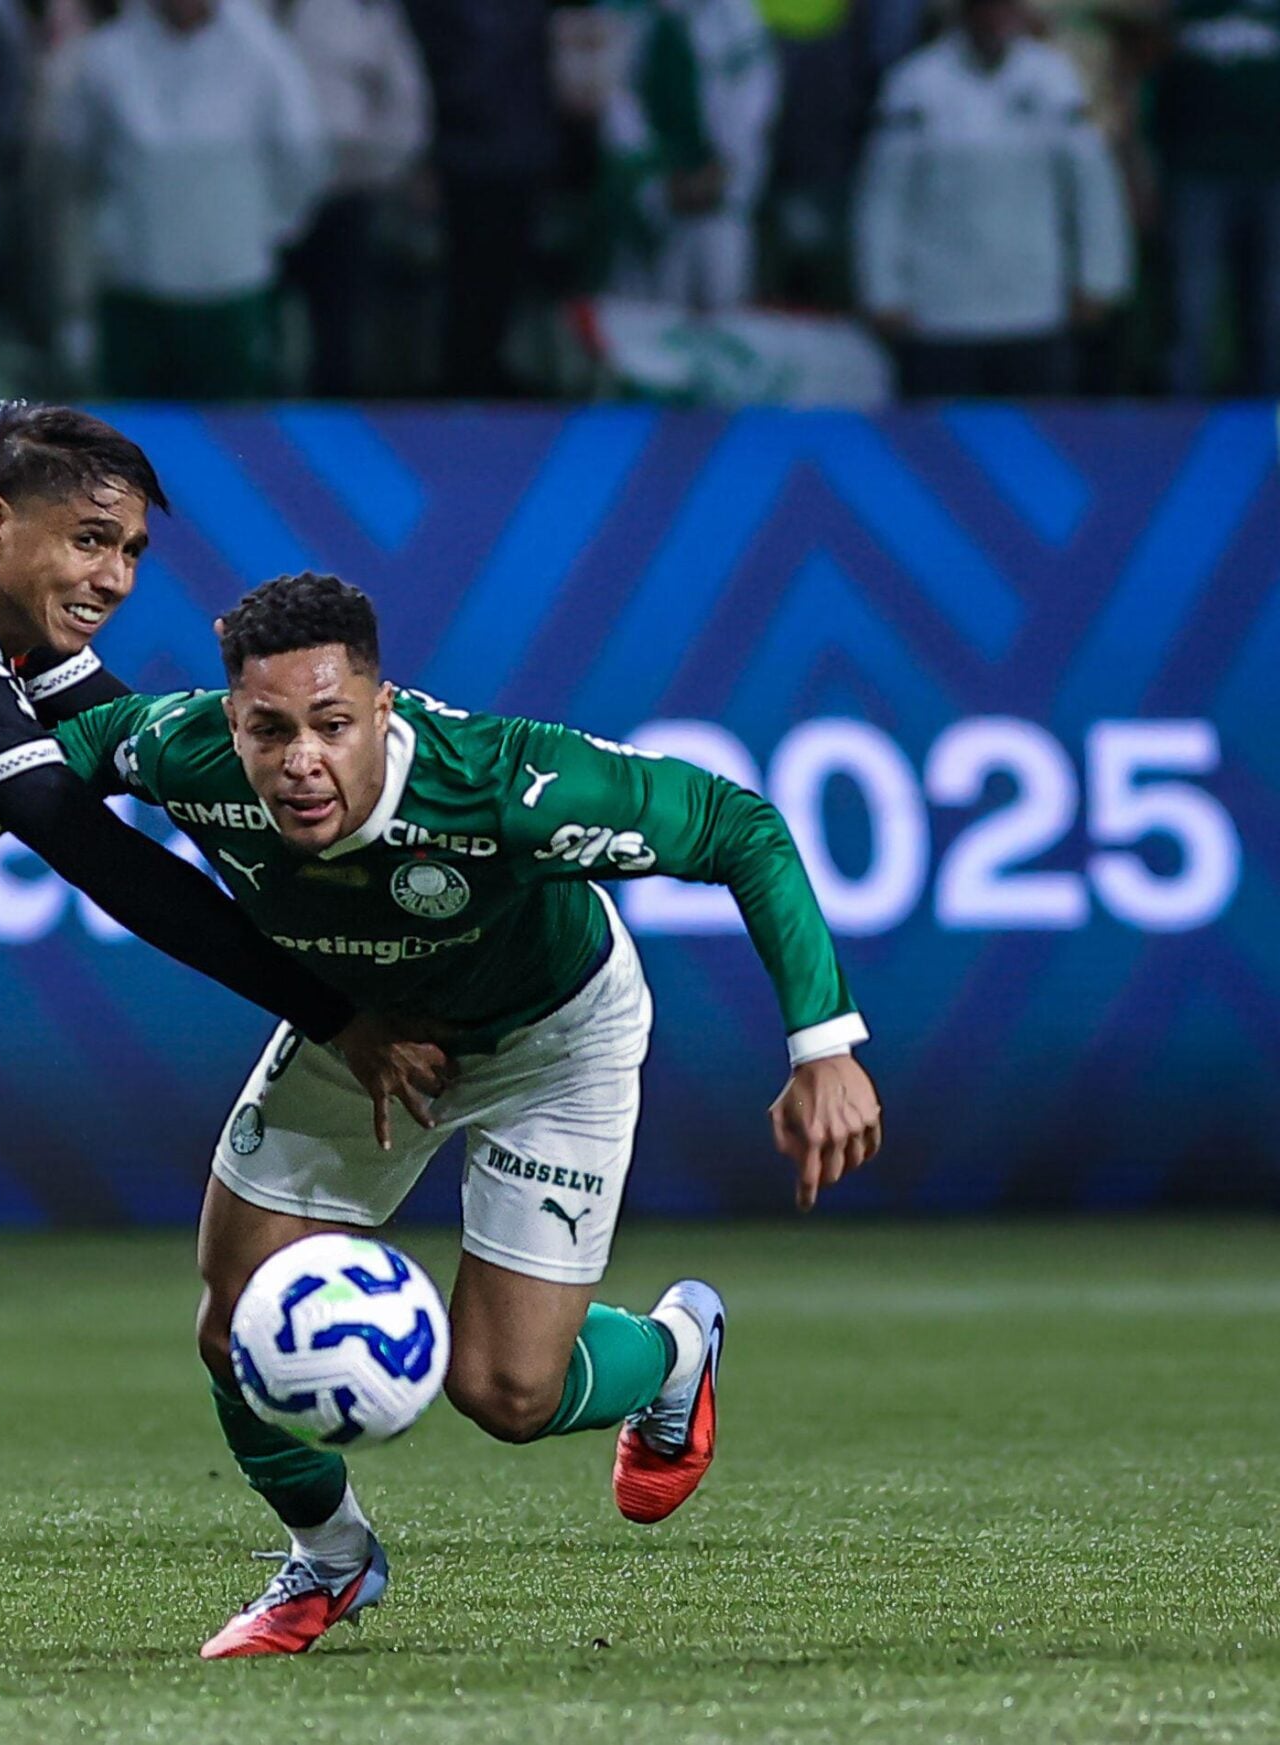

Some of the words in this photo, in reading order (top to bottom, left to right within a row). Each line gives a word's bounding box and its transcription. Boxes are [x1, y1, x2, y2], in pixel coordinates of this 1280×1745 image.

[167, 800, 268, 831] CIMED
[382, 818, 498, 857] CIMED
[487, 1146, 604, 1196] UNIASSELVI
